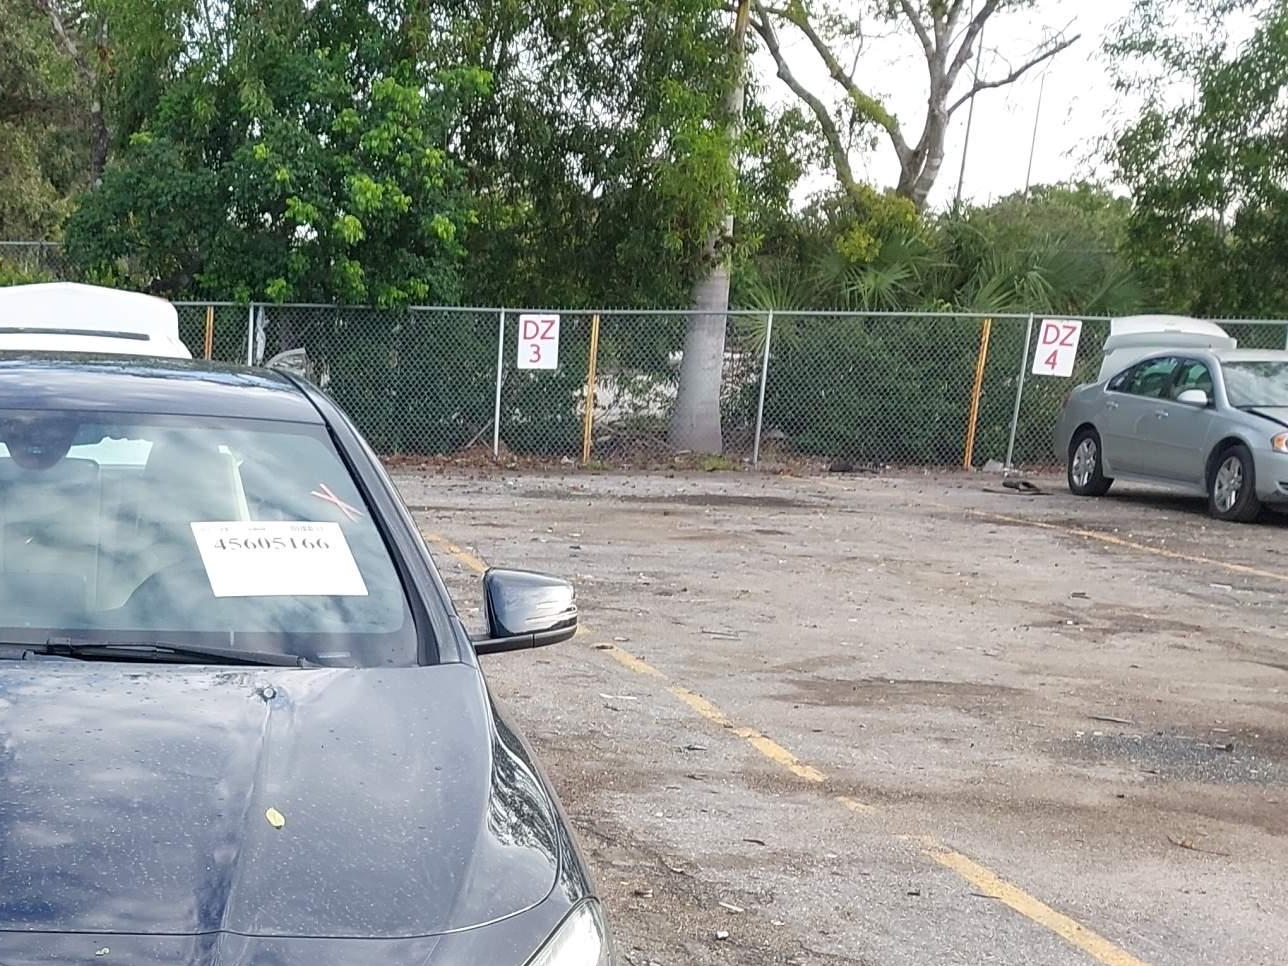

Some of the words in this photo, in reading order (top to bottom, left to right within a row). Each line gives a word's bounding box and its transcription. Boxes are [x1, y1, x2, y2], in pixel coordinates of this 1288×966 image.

[523, 320, 556, 340] DZ
[1042, 324, 1077, 347] DZ
[529, 344, 541, 363] 3
[1044, 349, 1058, 370] 4
[214, 537, 330, 550] 45605166
